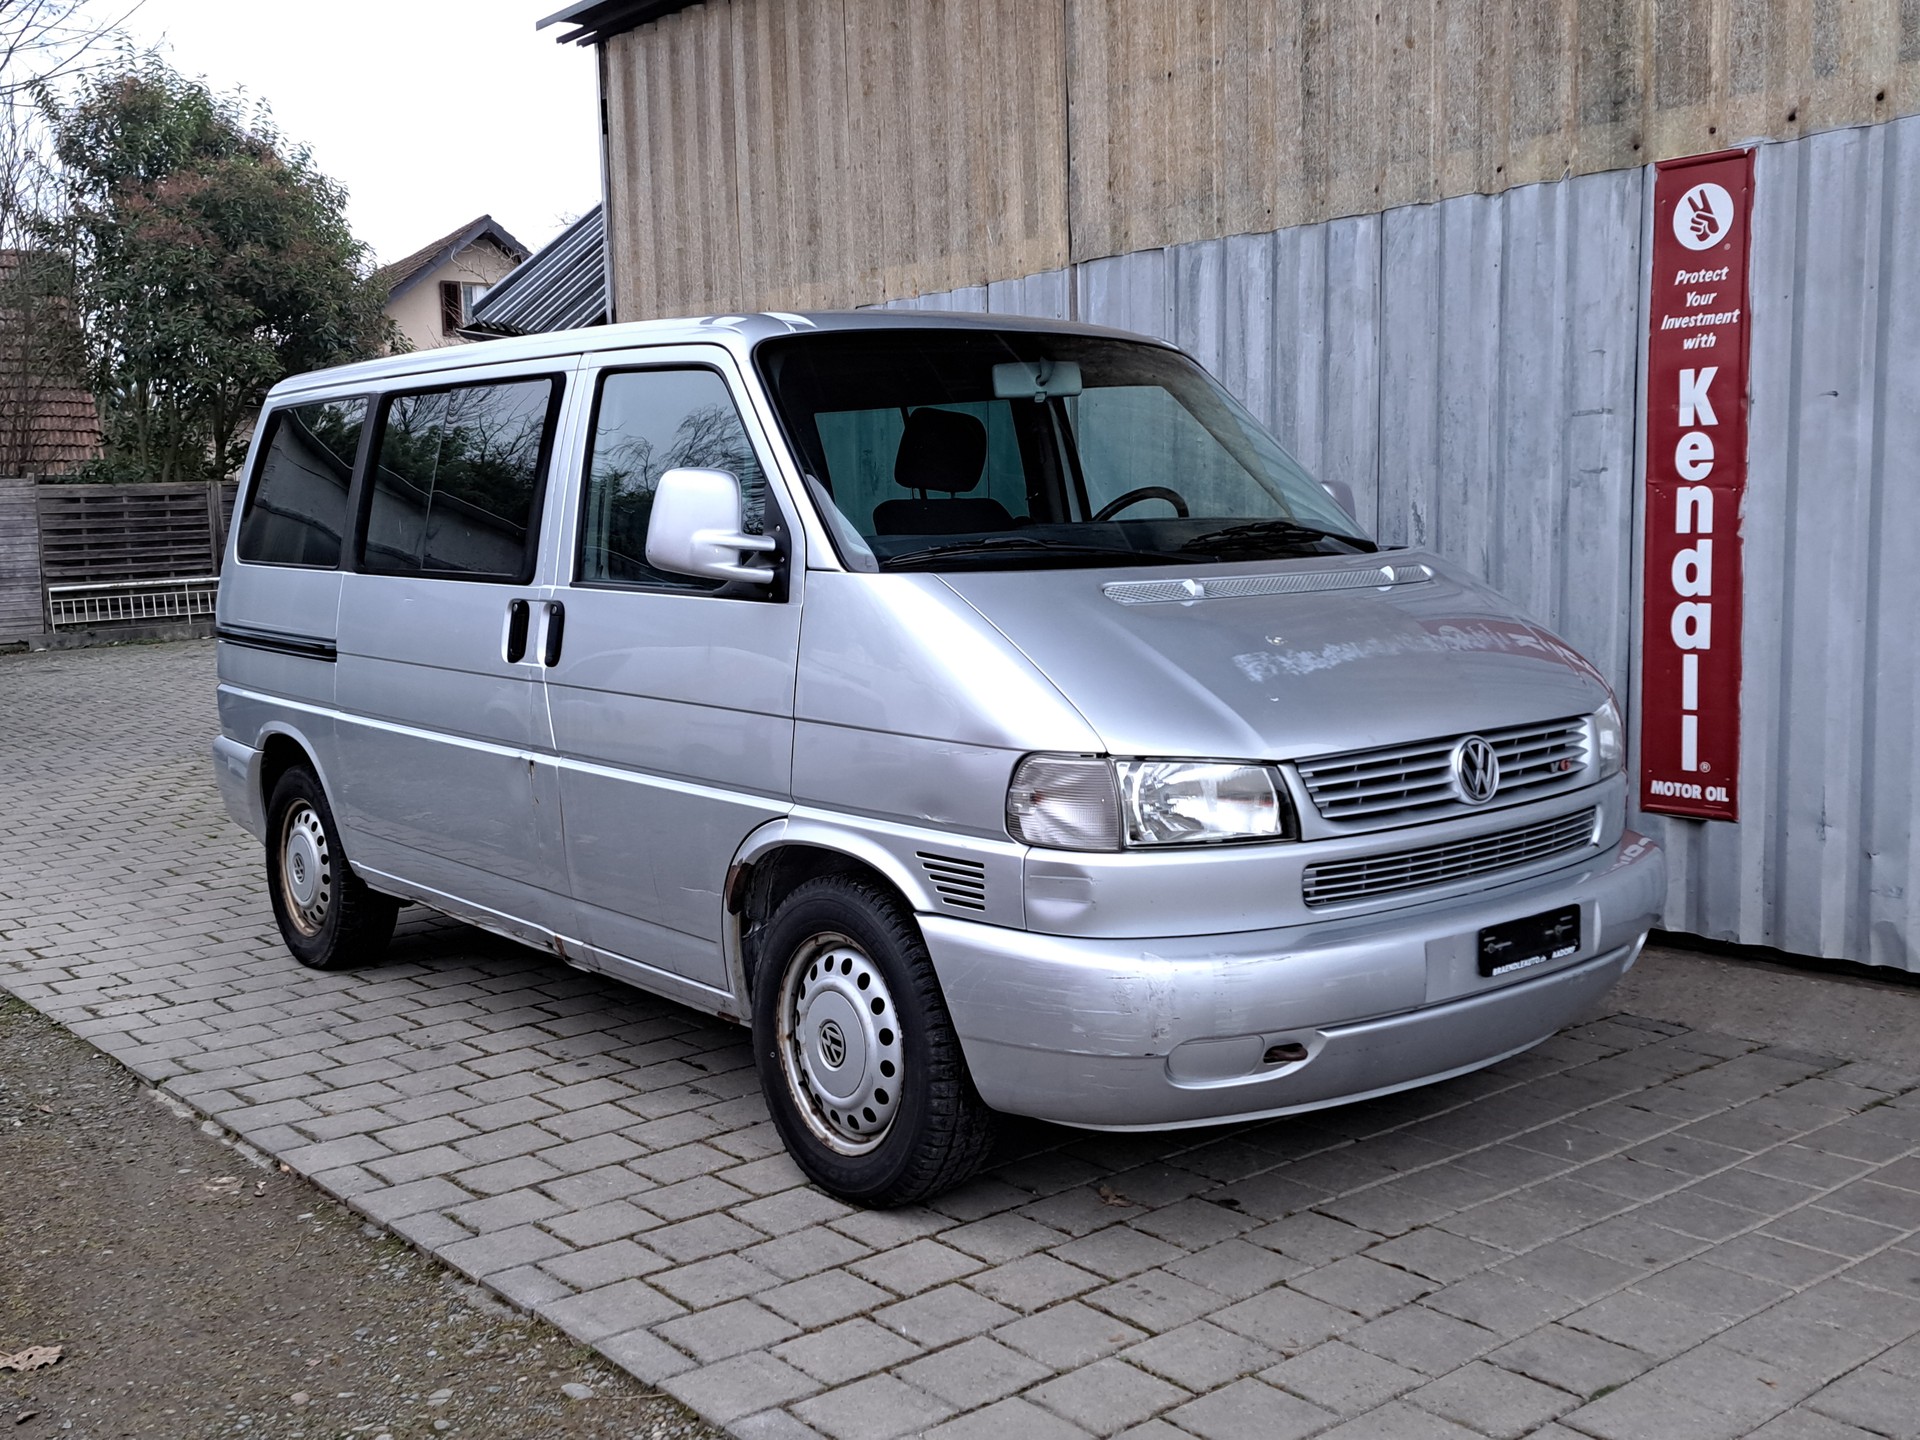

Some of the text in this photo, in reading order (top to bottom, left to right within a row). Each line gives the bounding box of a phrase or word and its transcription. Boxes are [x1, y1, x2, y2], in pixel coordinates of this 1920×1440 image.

[1674, 266, 1729, 285] Protect
[1686, 291, 1717, 307] Your
[1661, 308, 1741, 330] Investment
[1683, 332, 1717, 350] with
[1670, 366, 1719, 772] Kendall
[1650, 780, 1730, 802] MOTOR OIL
